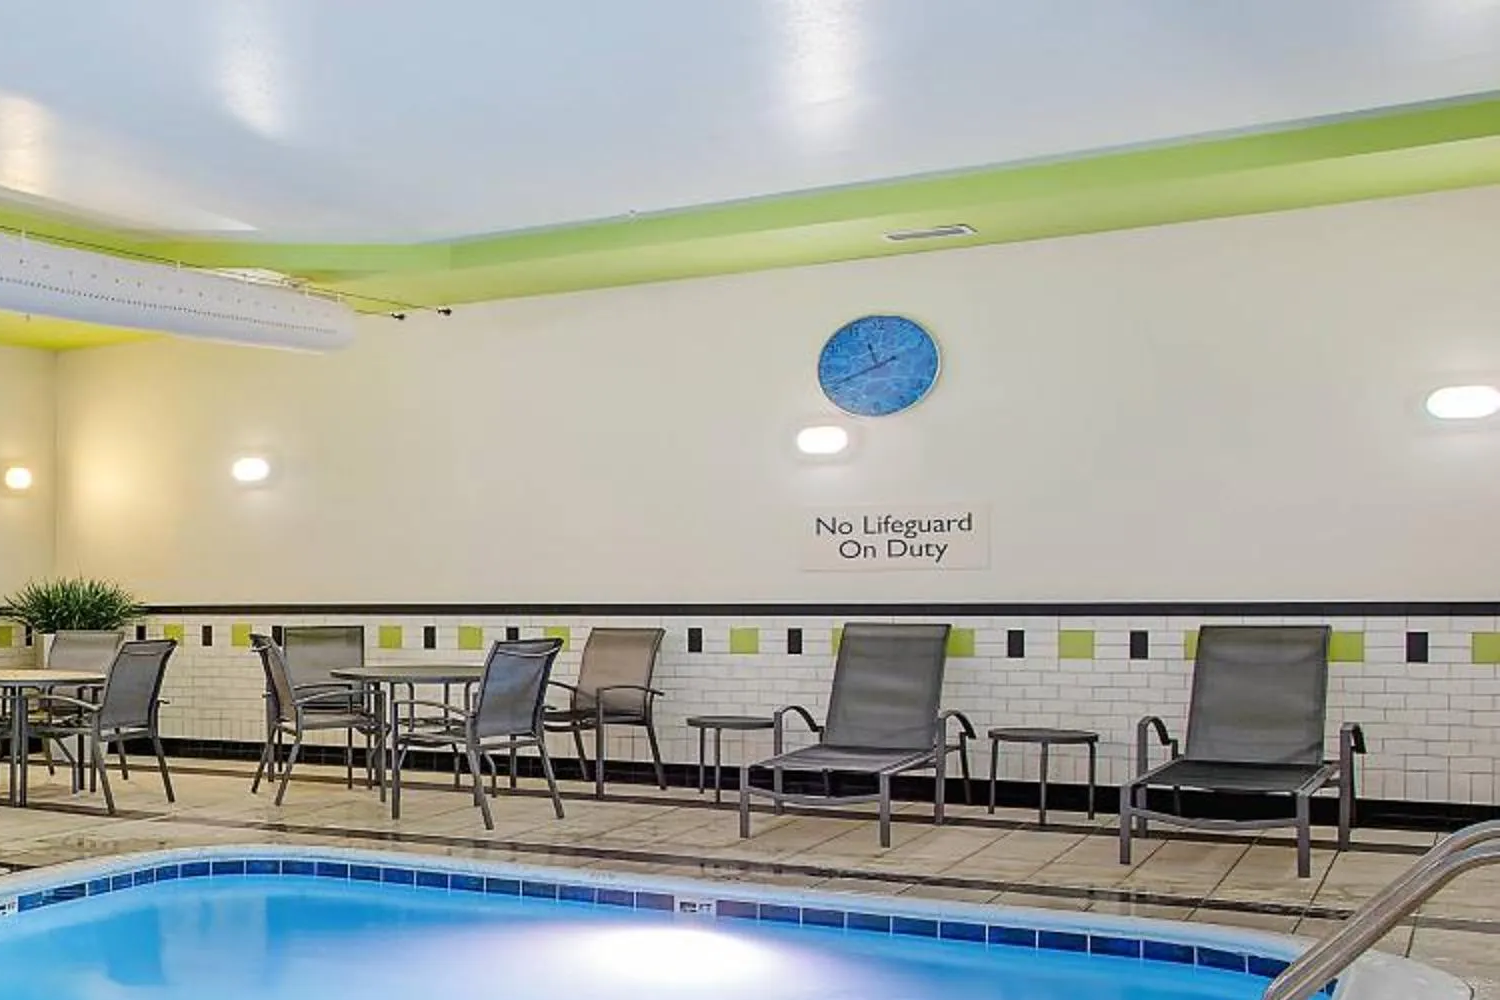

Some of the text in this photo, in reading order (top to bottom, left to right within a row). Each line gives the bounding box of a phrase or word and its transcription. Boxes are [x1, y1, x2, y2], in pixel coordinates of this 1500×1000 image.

[815, 512, 973, 538] No Lifeguard
[839, 539, 948, 563] On Duty
